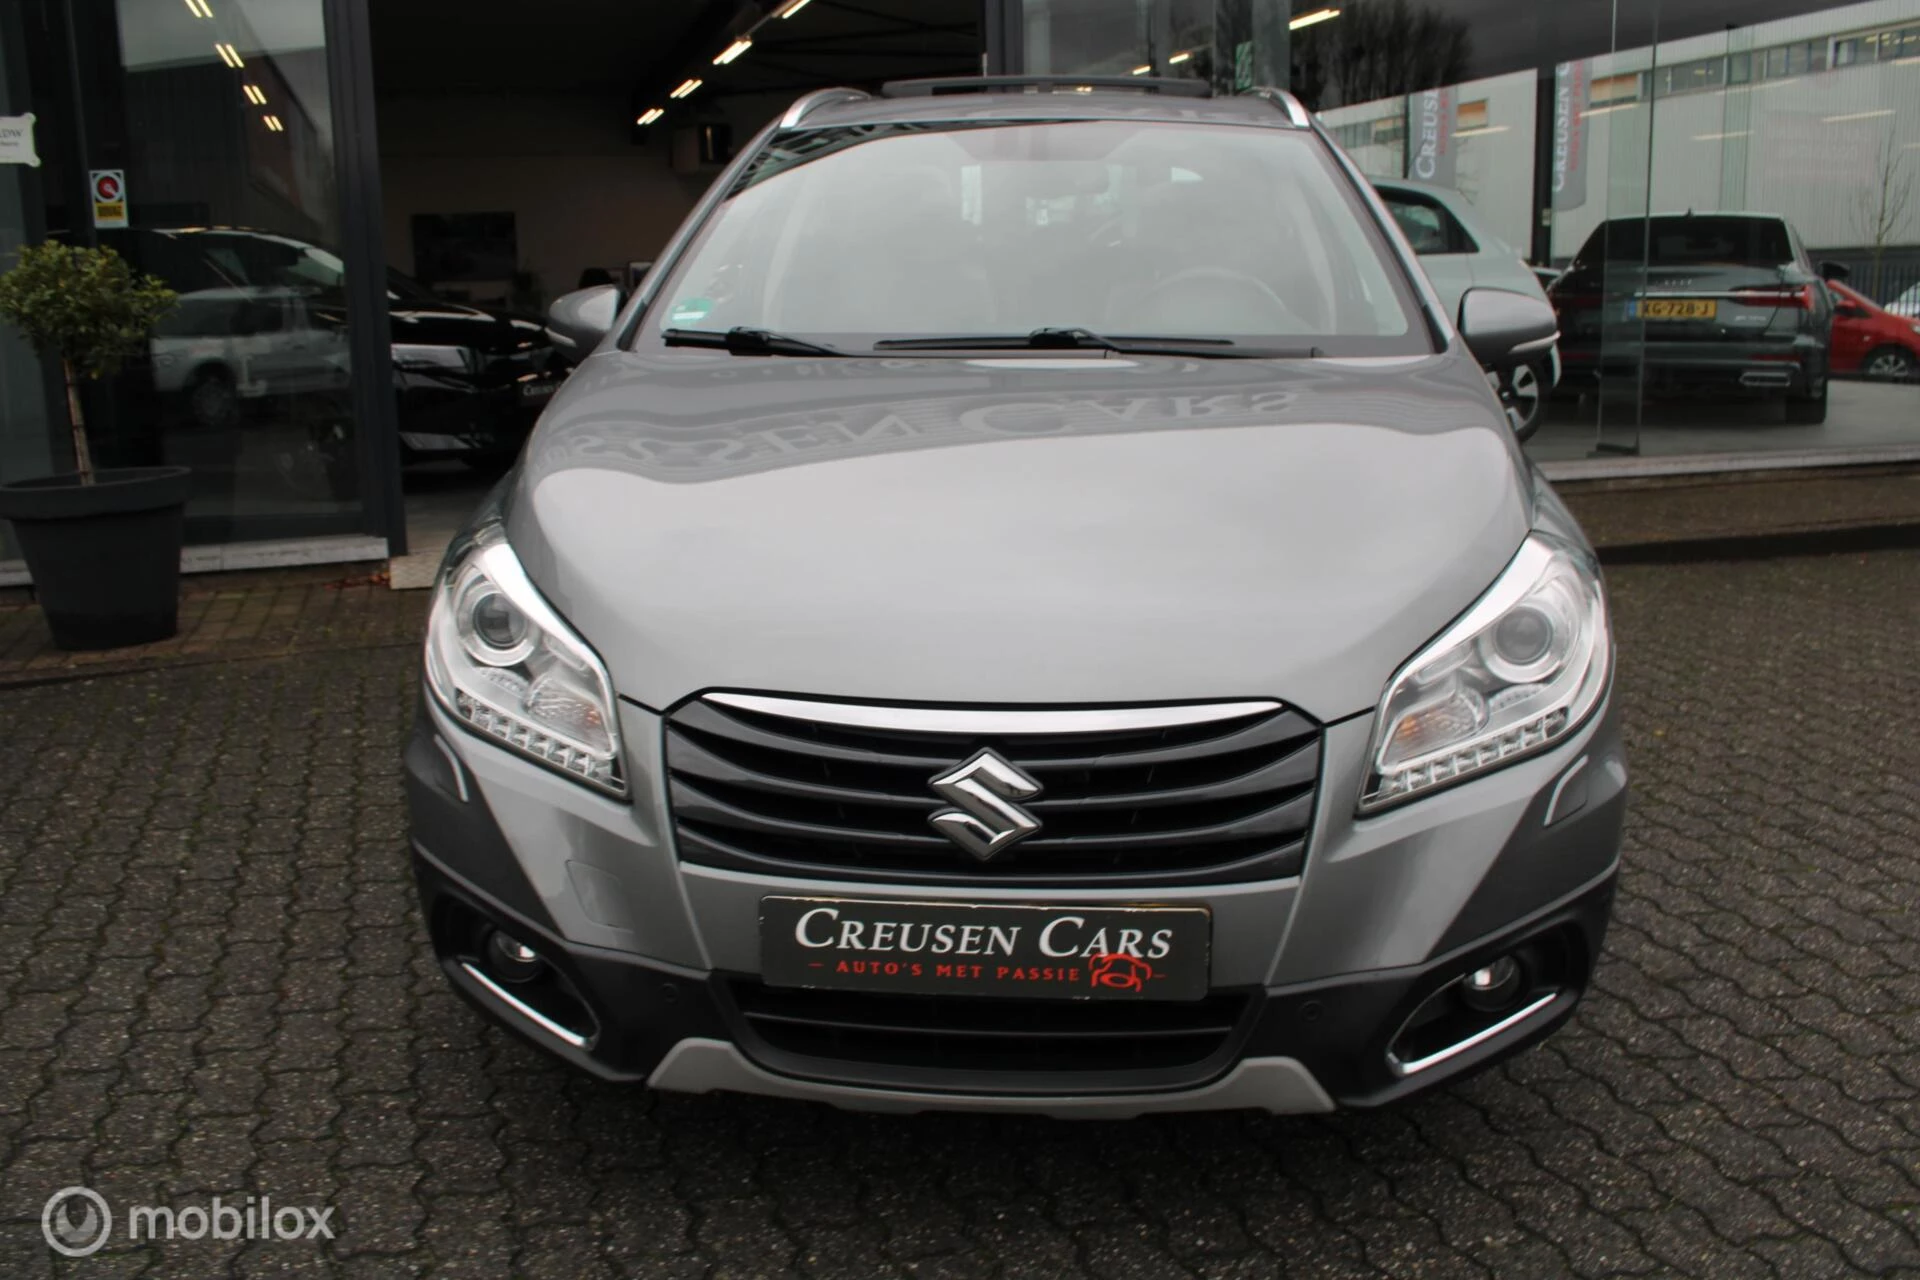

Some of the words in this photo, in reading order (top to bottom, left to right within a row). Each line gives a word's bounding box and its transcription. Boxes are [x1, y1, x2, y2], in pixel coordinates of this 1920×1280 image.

[795, 908, 1022, 957] CREUSEN
[1039, 916, 1172, 959] CARS
[836, 960, 923, 977] AUTO'S
[936, 964, 983, 979] MET
[997, 967, 1080, 981] PASSIE
